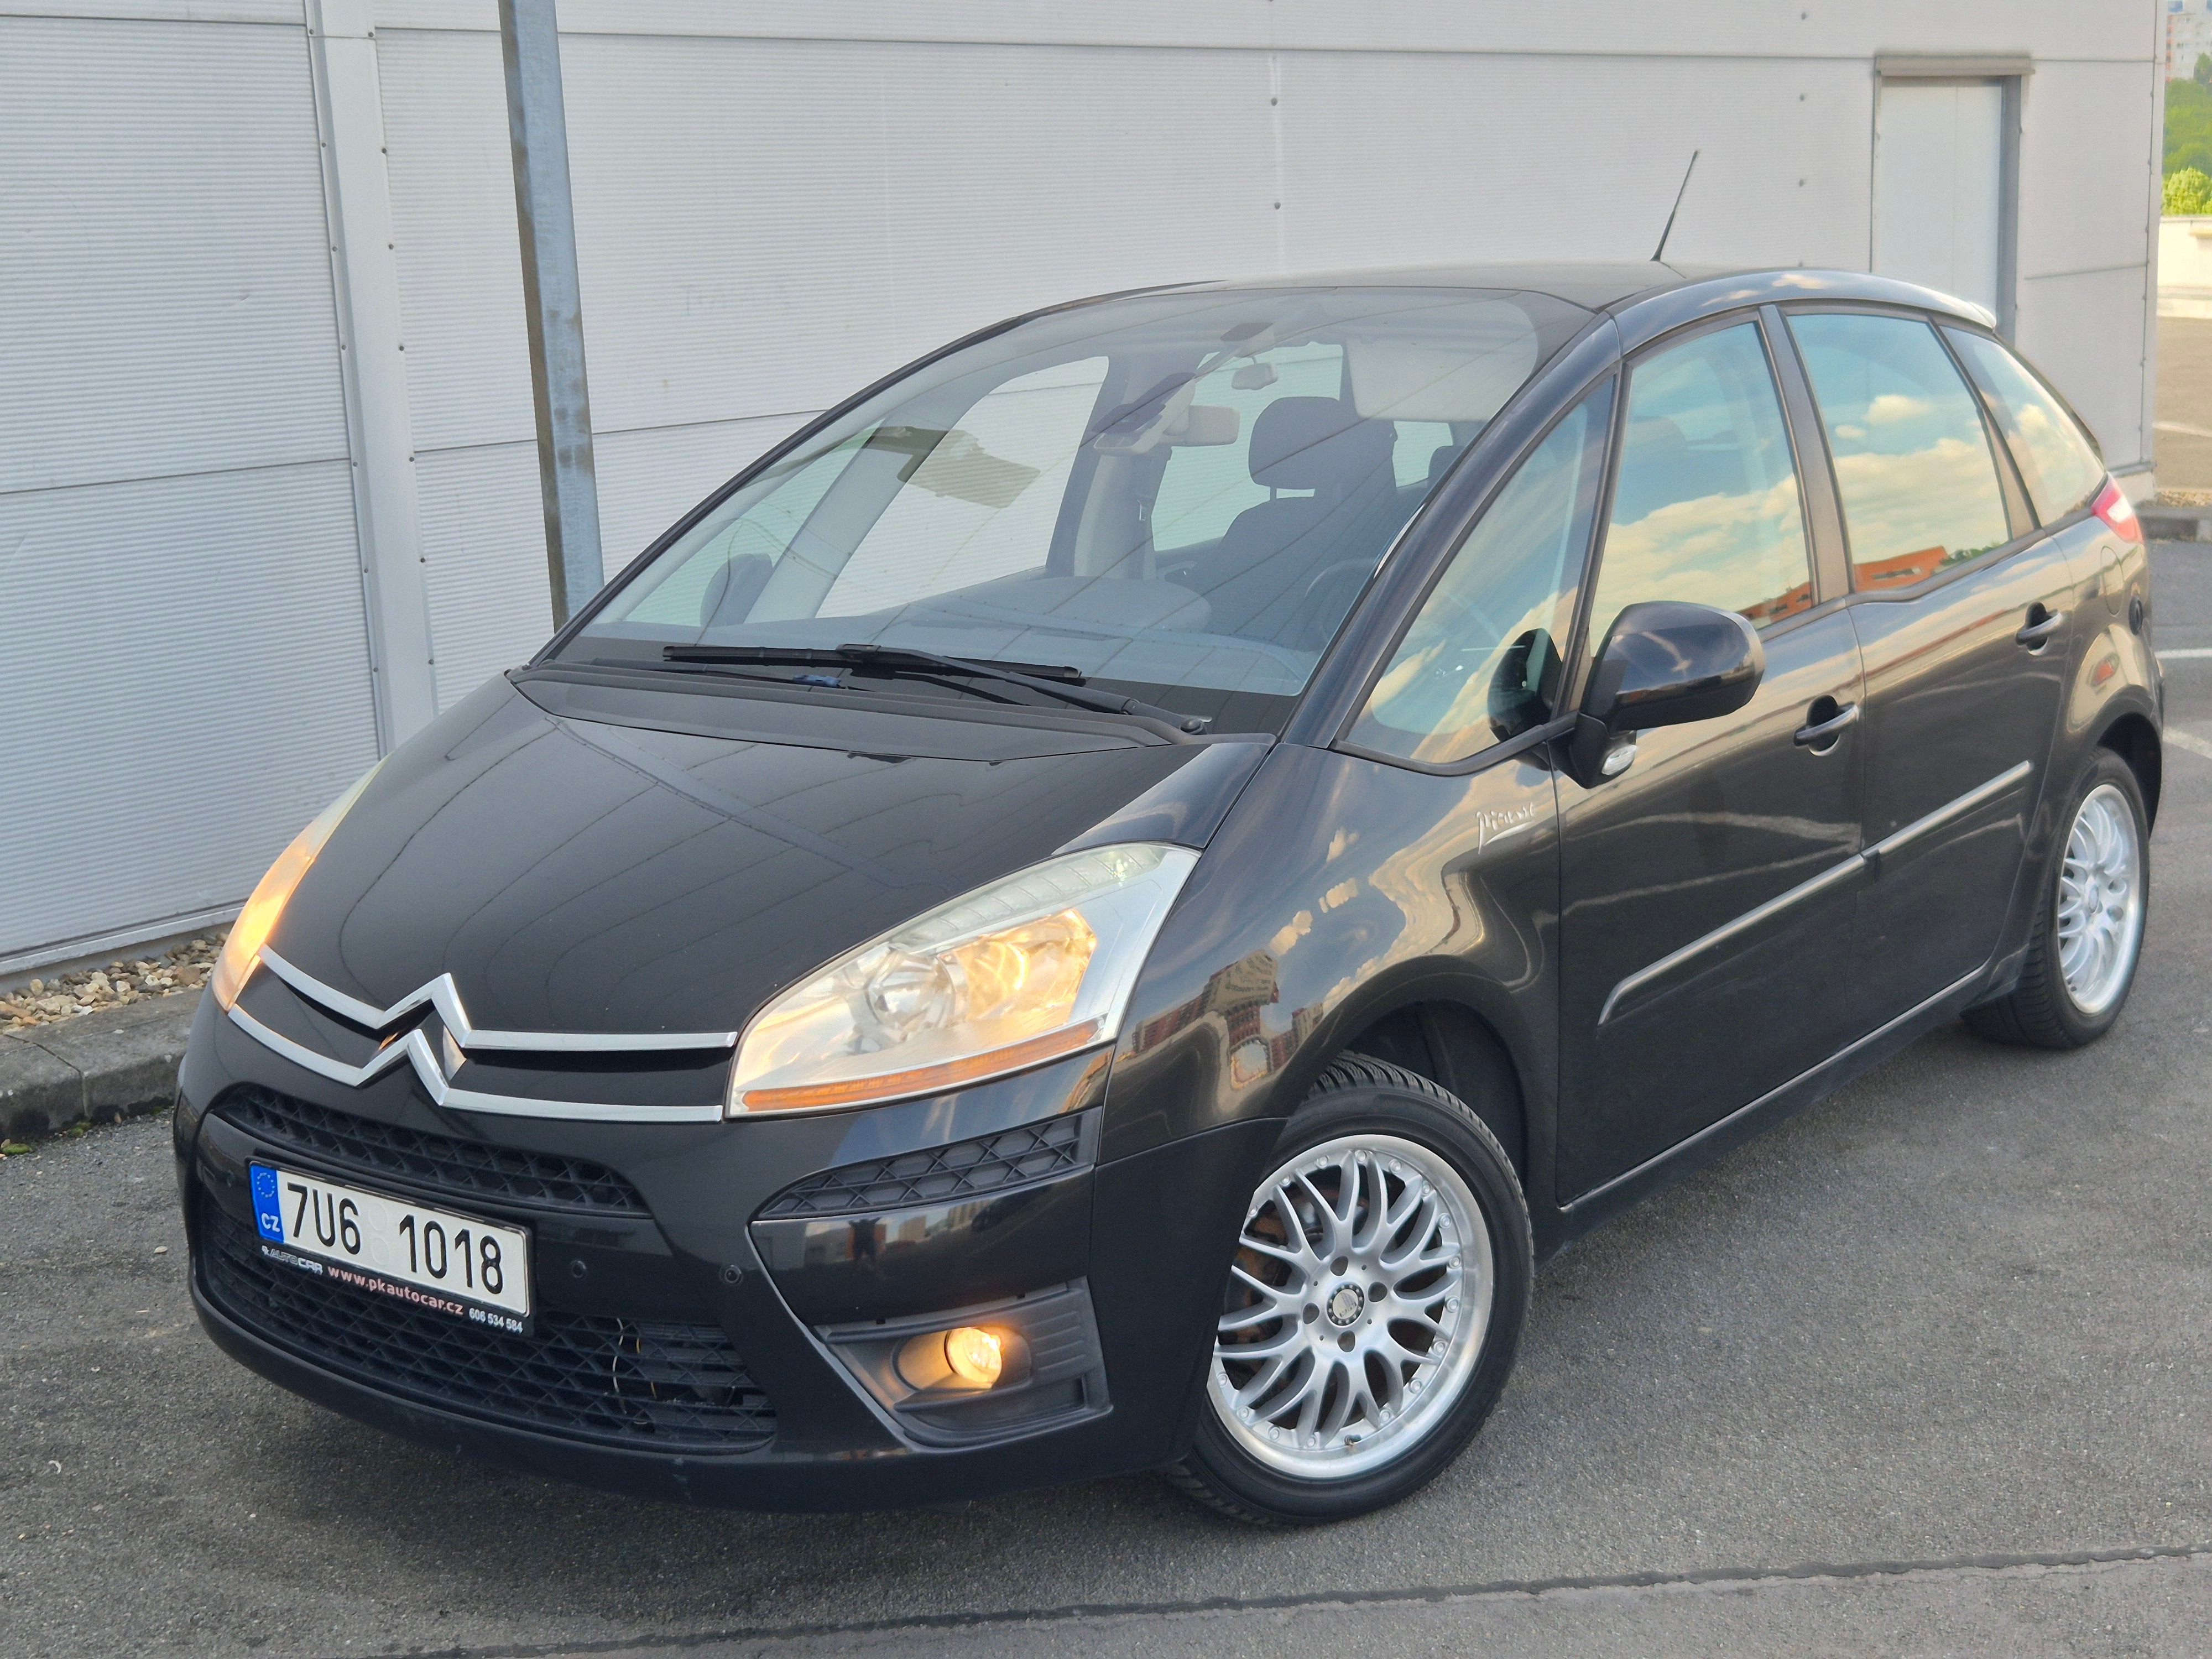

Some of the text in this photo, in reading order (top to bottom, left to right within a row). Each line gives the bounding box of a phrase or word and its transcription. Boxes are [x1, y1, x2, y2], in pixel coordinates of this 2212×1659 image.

[260, 1212, 280, 1233] CZ
[287, 1182, 503, 1295] 7U6 1018
[327, 1266, 465, 1316] www.pkautocar.cz
[487, 1313, 504, 1328] 534
